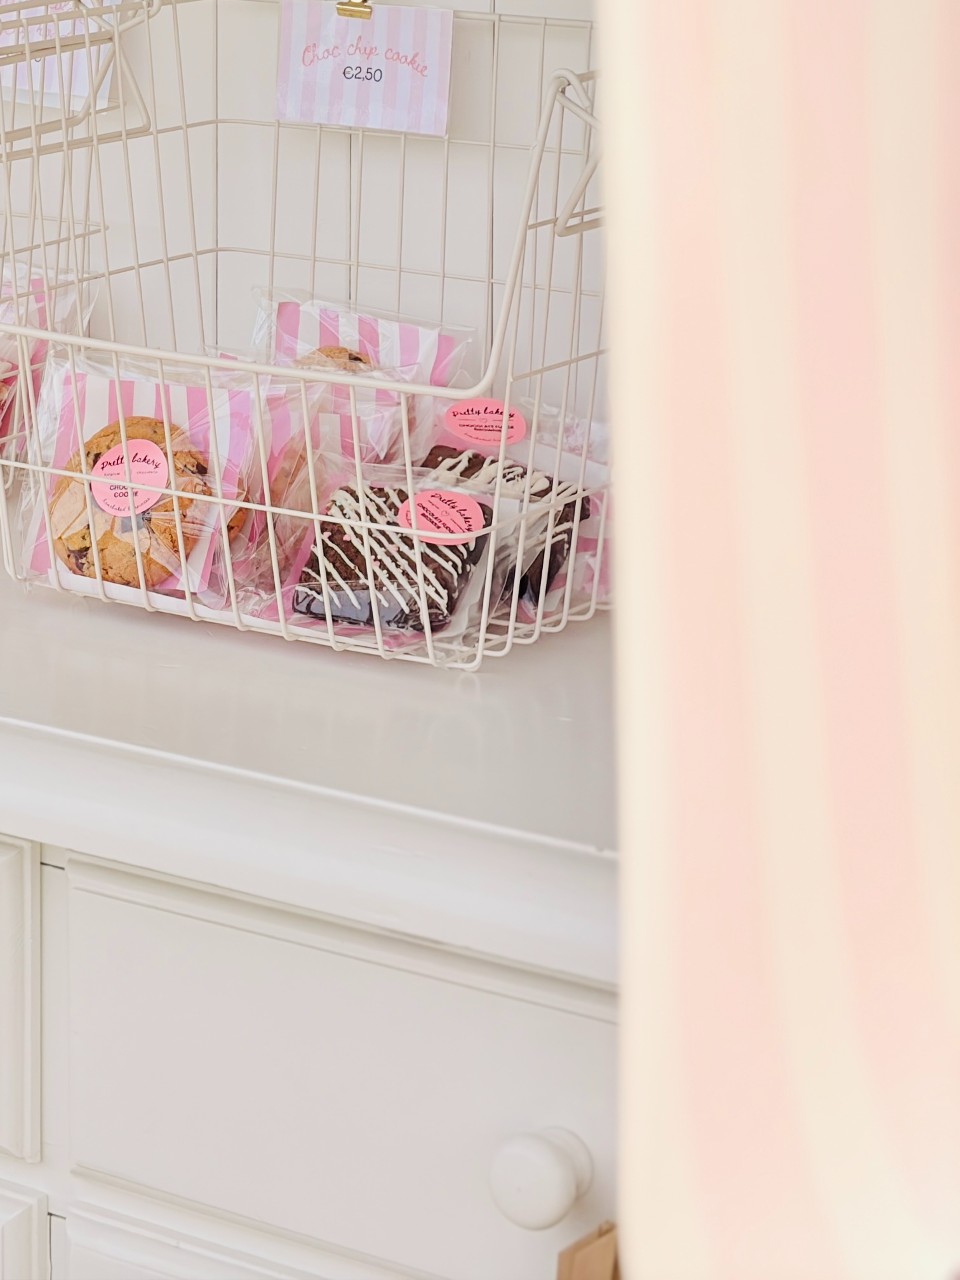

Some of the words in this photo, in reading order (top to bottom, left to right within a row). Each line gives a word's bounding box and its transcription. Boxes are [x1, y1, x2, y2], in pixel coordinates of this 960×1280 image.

[301, 42, 341, 67] Choc
[346, 35, 379, 60] chip
[384, 47, 428, 78] cookie
[342, 65, 383, 82] €2,50
[483, 406, 515, 418] bakey
[101, 455, 126, 471] Prett
[132, 452, 161, 469] bakery
